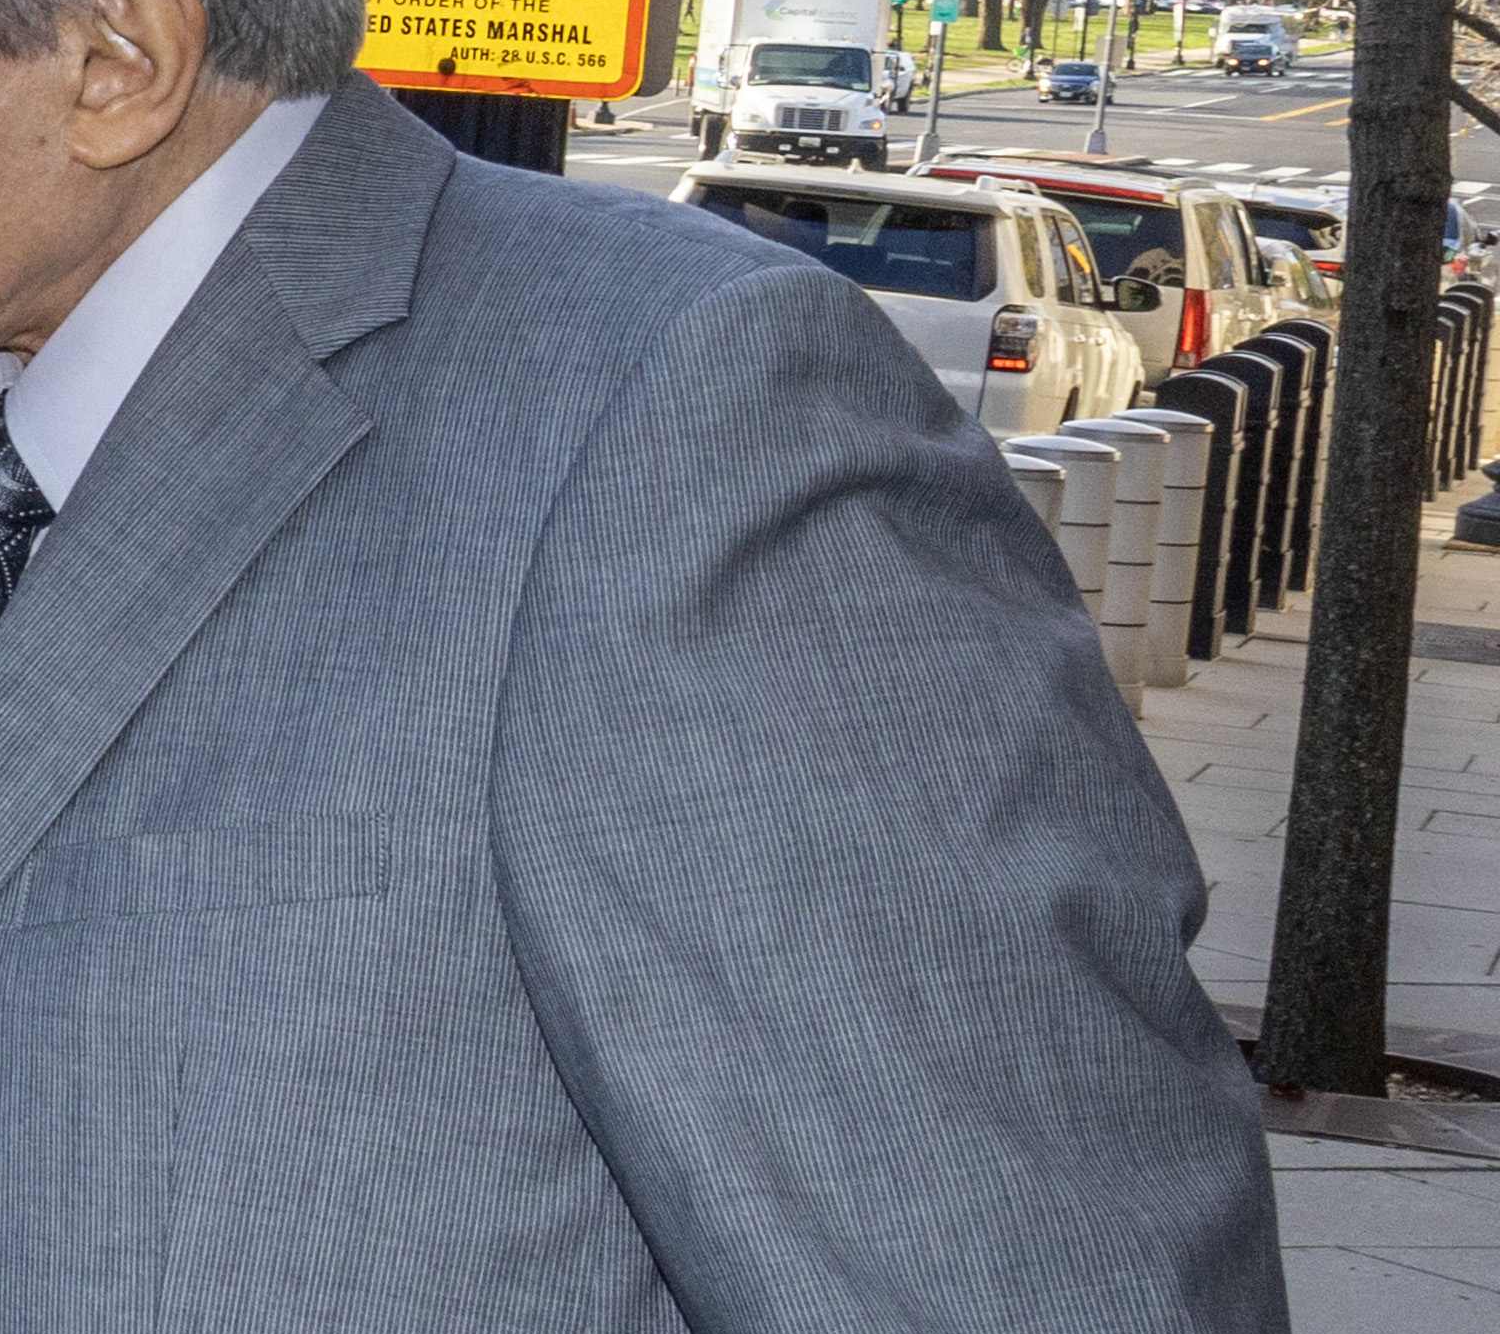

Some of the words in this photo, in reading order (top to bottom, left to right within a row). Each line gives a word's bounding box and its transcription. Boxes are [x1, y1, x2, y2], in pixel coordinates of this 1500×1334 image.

[401, 15, 477, 39] STATES
[487, 20, 594, 45] MARSHAL
[449, 46, 496, 63] AUTH:
[526, 51, 571, 67] U.S.C.
[577, 54, 607, 68] 566
